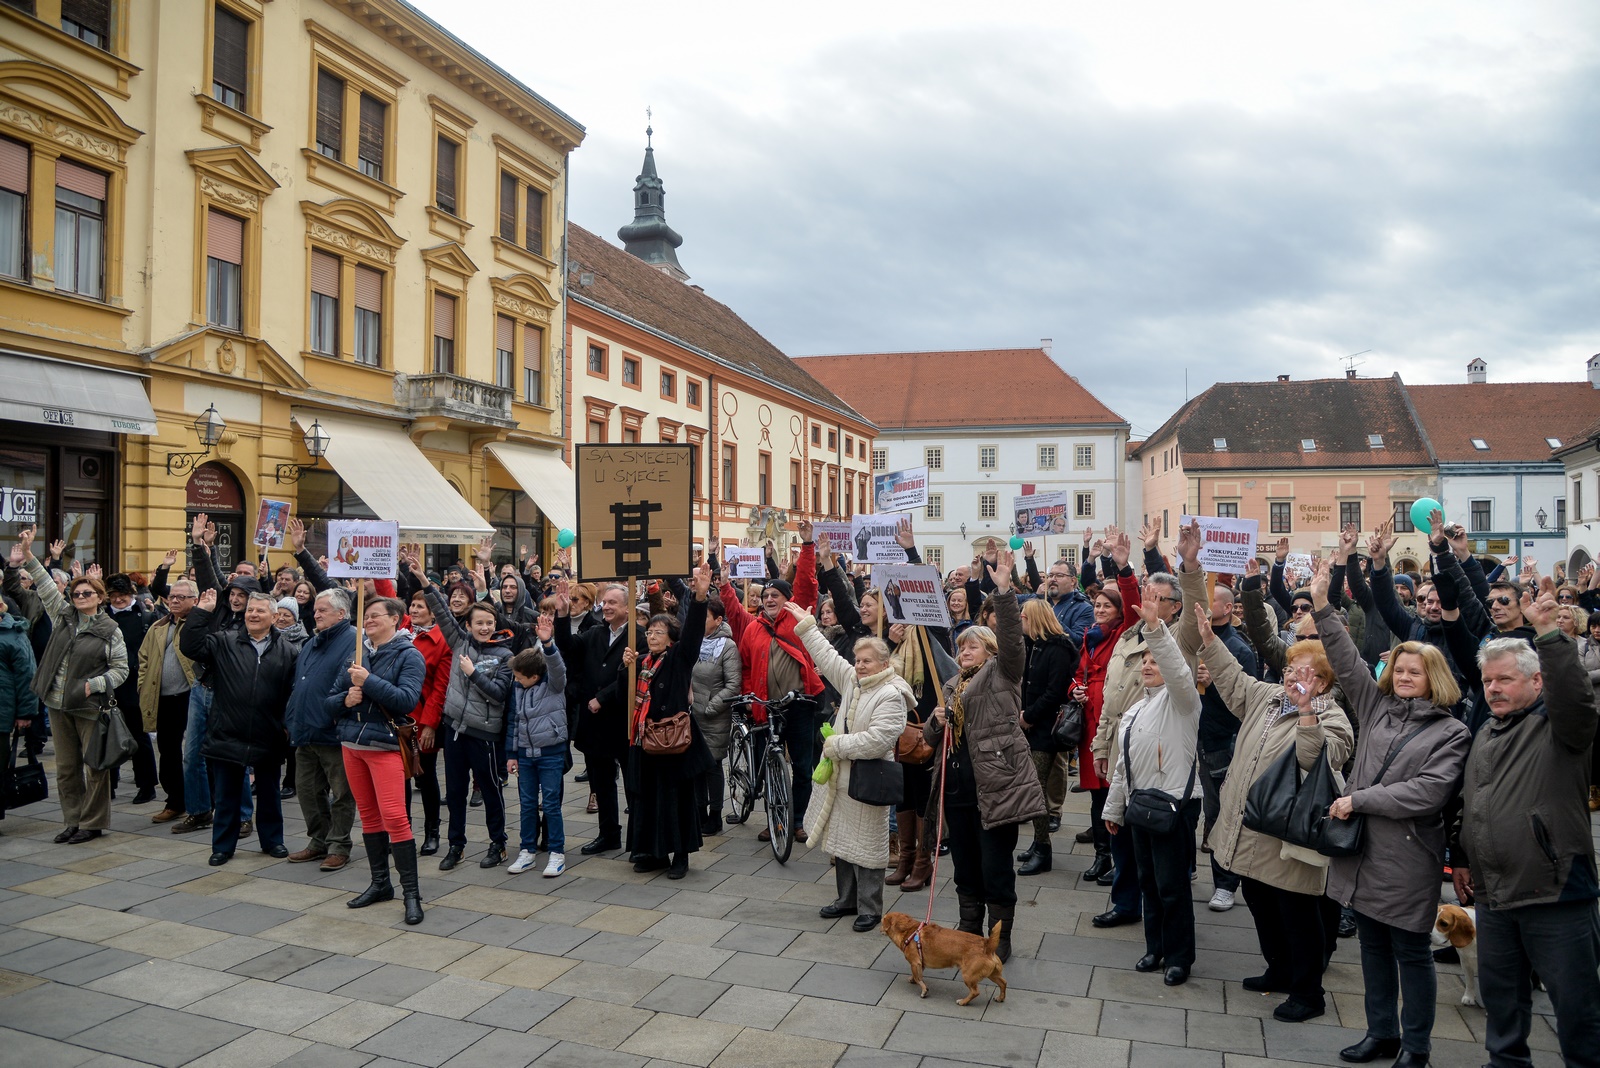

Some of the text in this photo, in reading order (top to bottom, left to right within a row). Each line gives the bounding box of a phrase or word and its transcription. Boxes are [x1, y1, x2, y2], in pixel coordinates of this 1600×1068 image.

[111, 420, 141, 430] TUBORG
[586, 449, 689, 466] SA SMEĆEM
[594, 468, 671, 483] U SMEĆE
[1300, 504, 1331, 512] Centar
